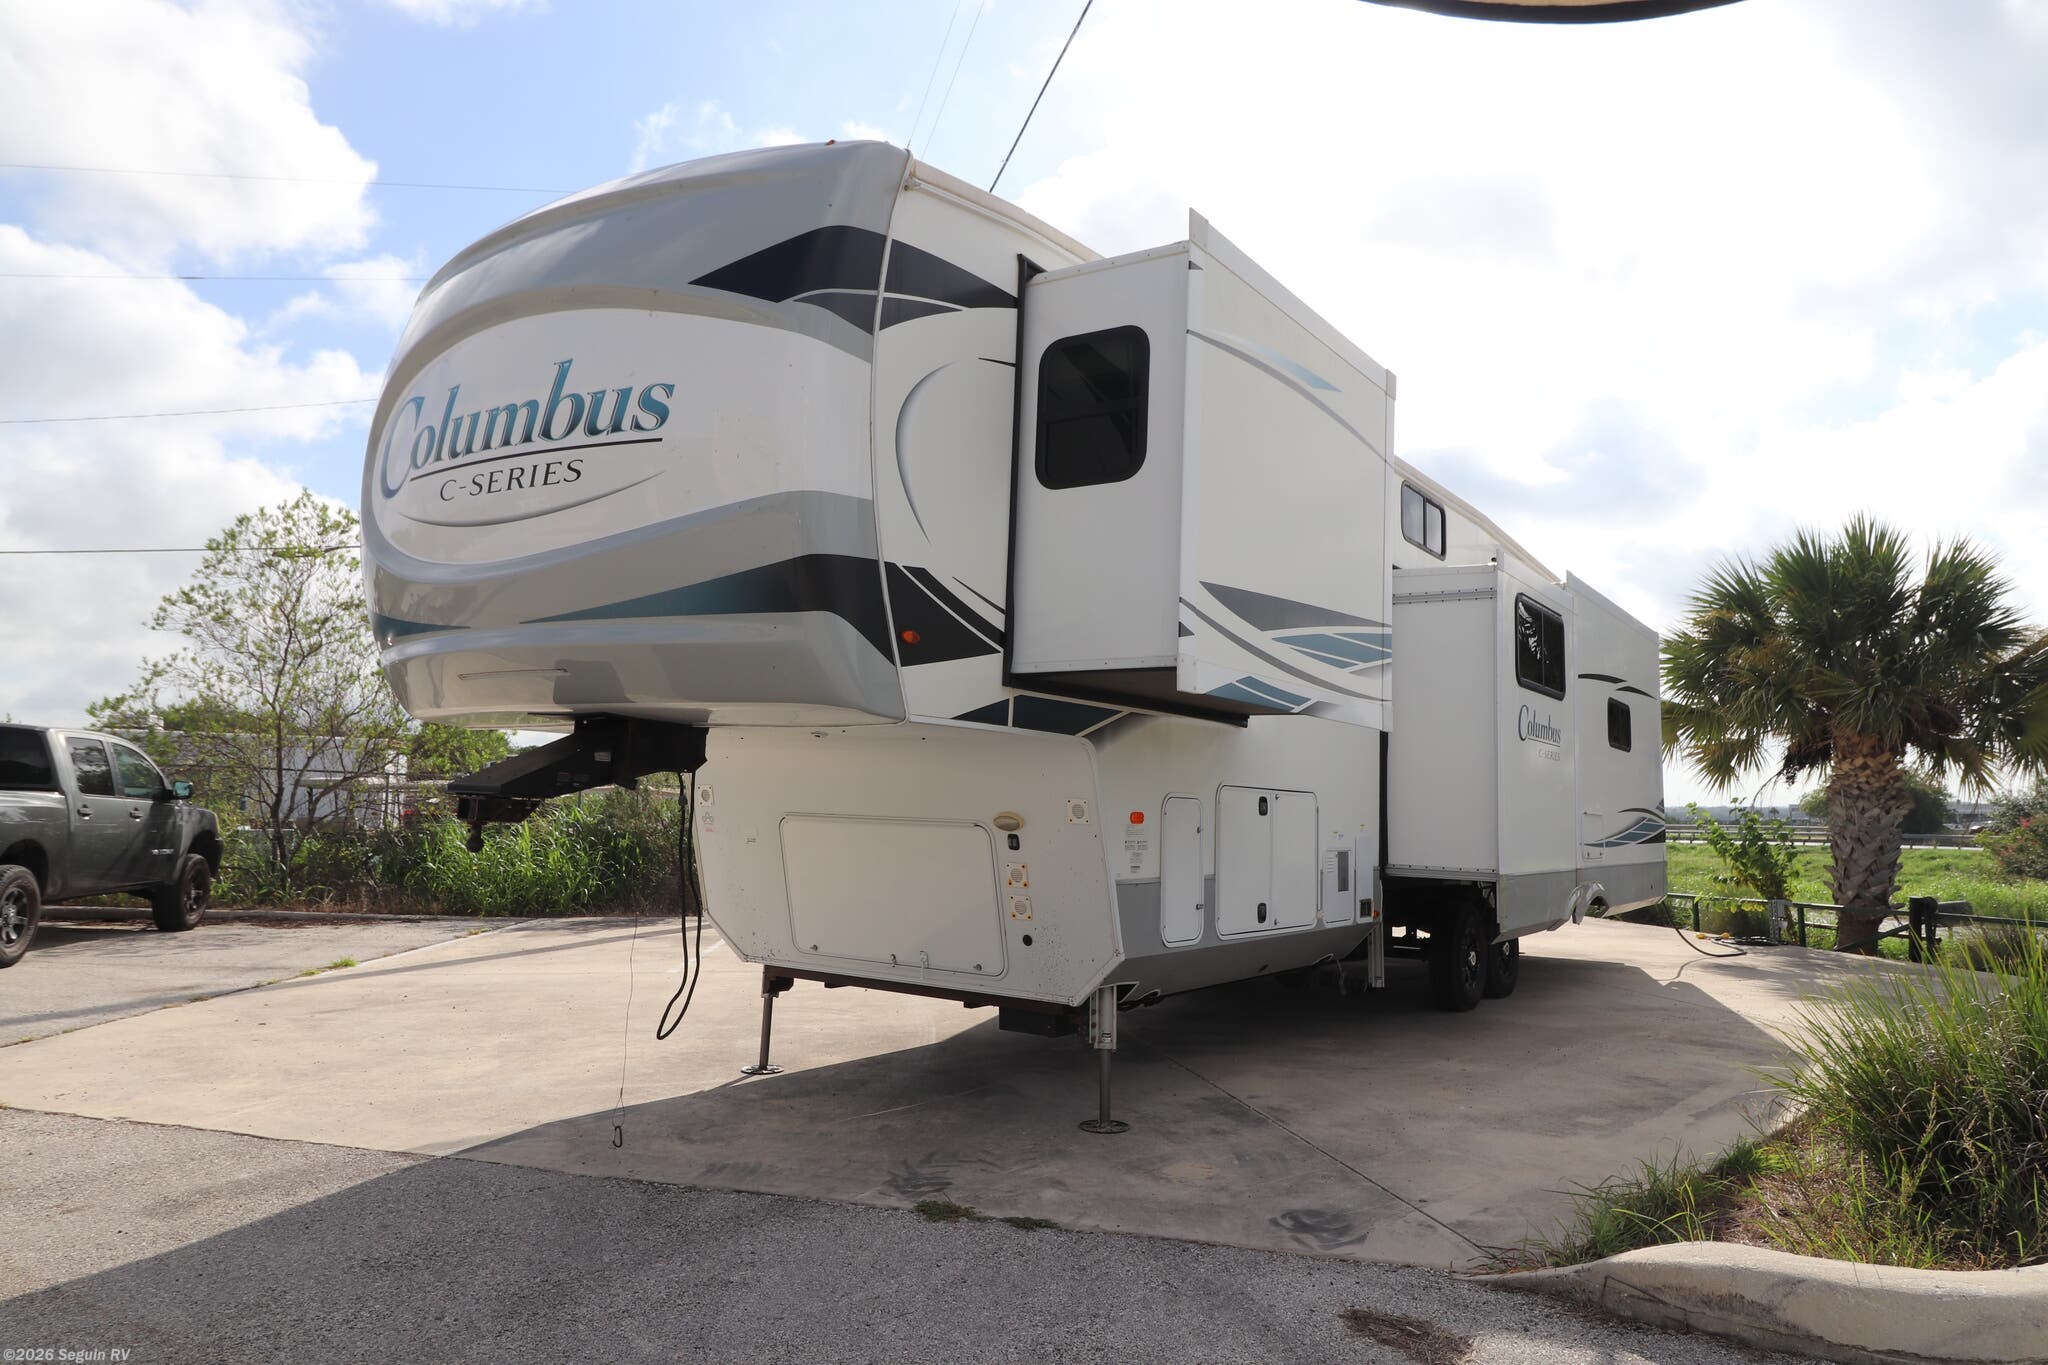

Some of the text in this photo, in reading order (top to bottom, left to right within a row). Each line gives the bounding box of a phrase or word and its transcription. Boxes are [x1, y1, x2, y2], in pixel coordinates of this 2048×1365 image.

[380, 358, 675, 499] Columbus
[440, 459, 584, 501] C-SERIES
[1518, 704, 1561, 744] Columbus
